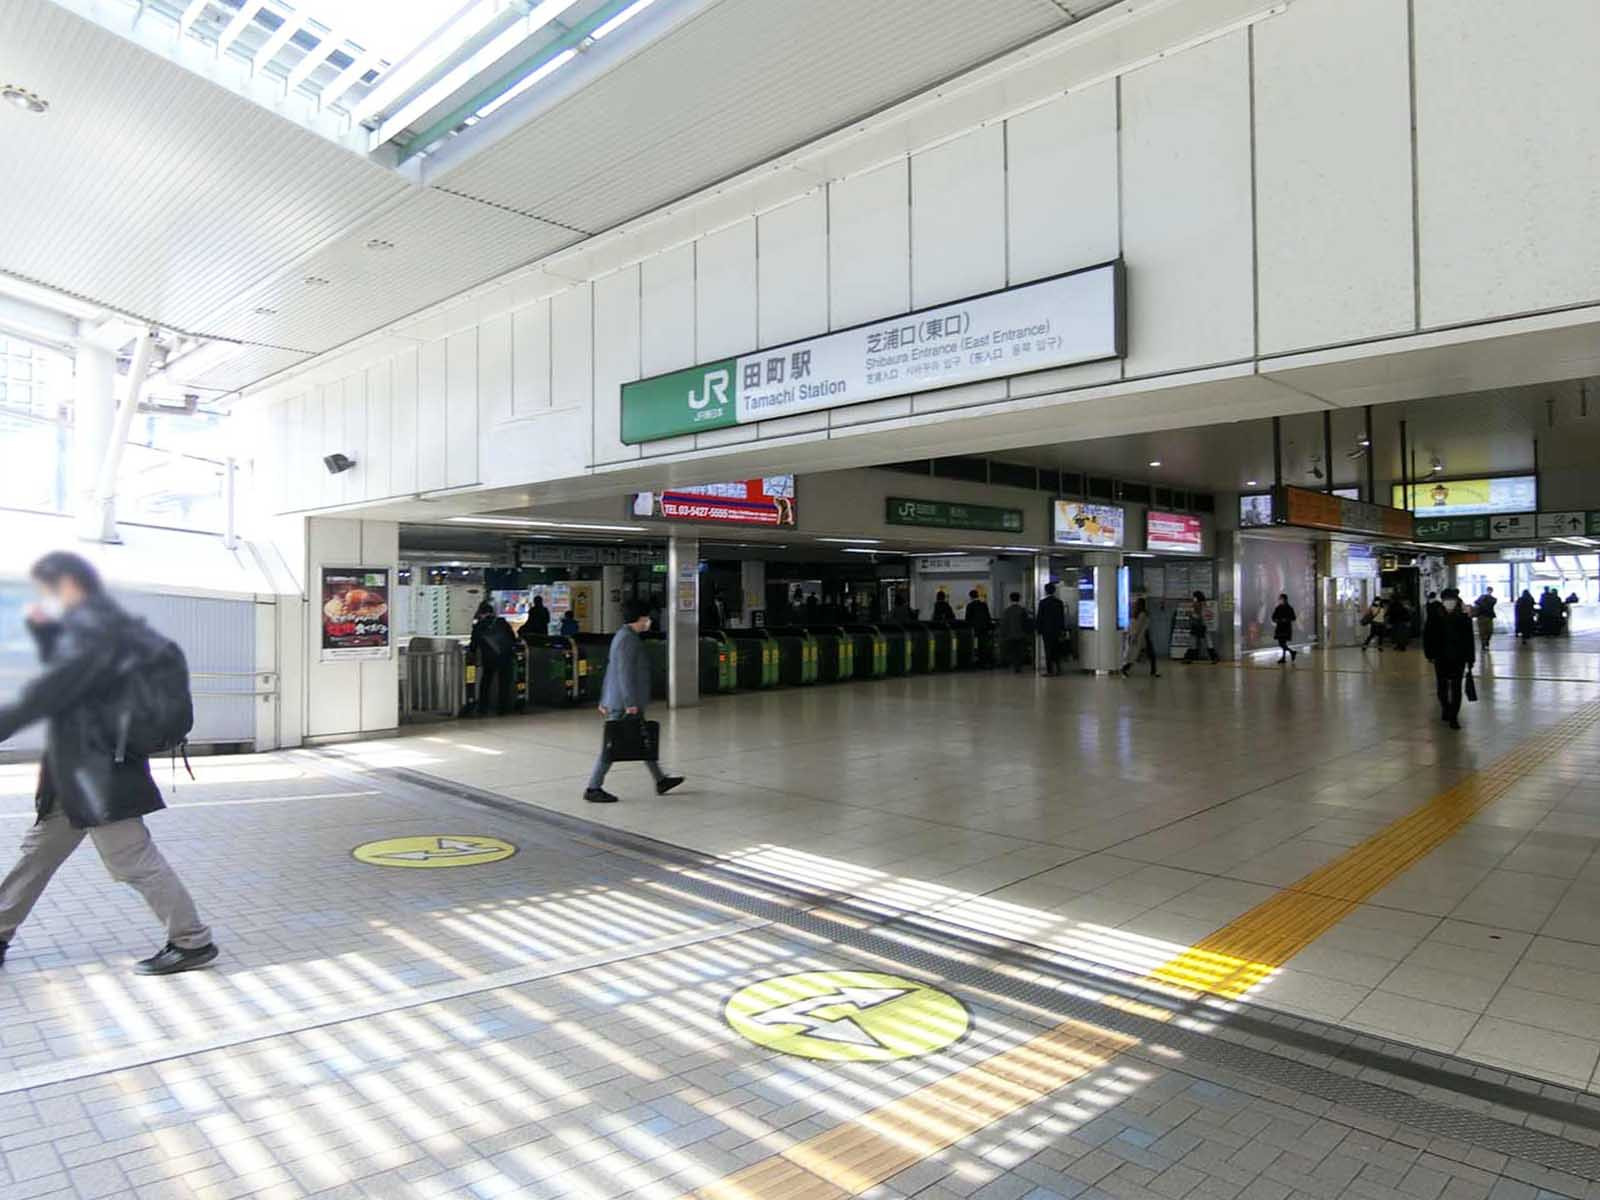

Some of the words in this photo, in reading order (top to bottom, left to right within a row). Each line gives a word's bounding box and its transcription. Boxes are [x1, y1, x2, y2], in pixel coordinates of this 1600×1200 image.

[865, 353, 909, 370] Shibaura
[911, 343, 957, 361] Entrance
[960, 334, 990, 351] (East
[993, 318, 1050, 344] Entrance)
[866, 312, 970, 354] 芝浦口(東口)
[688, 369, 729, 409] JR
[743, 350, 812, 390] 田町駅
[743, 388, 795, 411] Tamachi
[799, 379, 847, 401] Station
